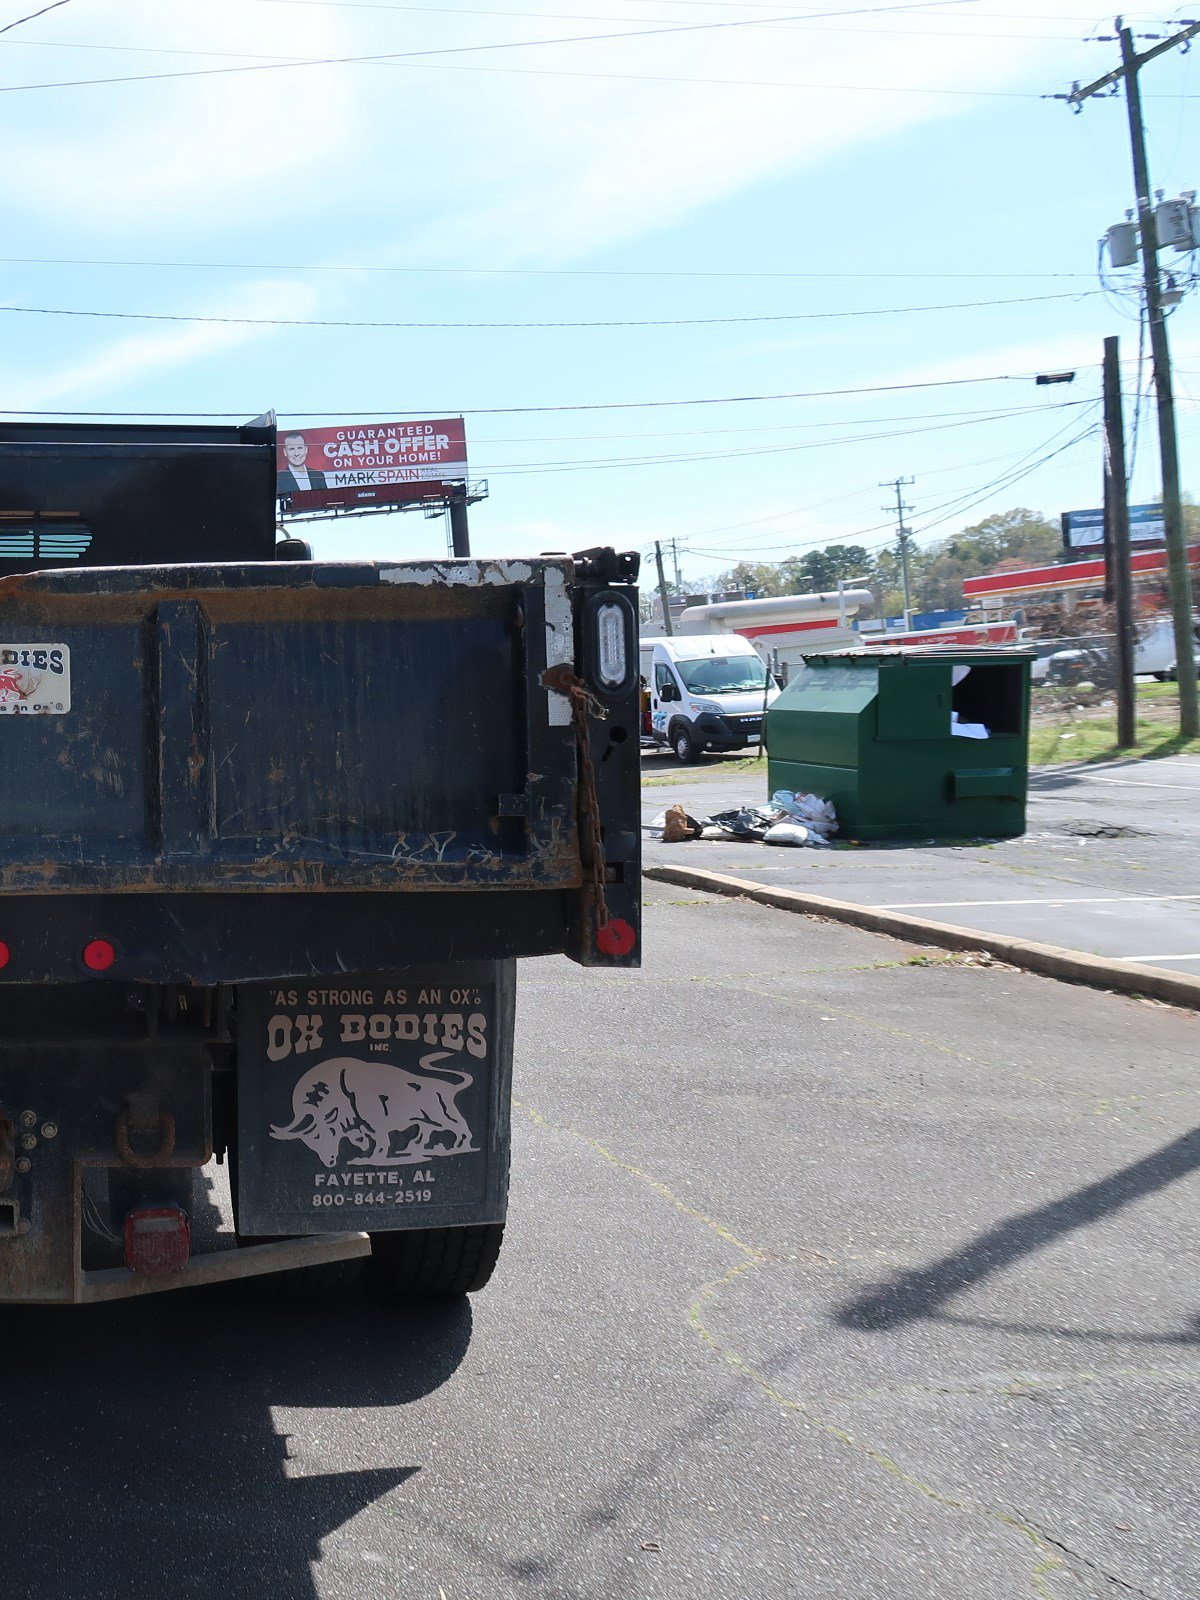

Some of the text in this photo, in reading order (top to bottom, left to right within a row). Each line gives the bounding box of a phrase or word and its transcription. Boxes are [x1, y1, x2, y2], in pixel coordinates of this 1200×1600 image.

[337, 425, 434, 441] GUARANTEED
[323, 434, 450, 458] CASH OFFER
[333, 451, 442, 468] ON YOUR HOME!
[334, 467, 420, 486] MARK SPAIN
[12, 704, 28, 712] An
[307, 989, 374, 1006] STRONG
[383, 989, 407, 1005] AS
[417, 989, 441, 1005] AN
[266, 1012, 487, 1062] OX BODIES
[314, 1169, 436, 1187] FAYETTE, AL
[311, 1189, 432, 1207] 800-844-2519
